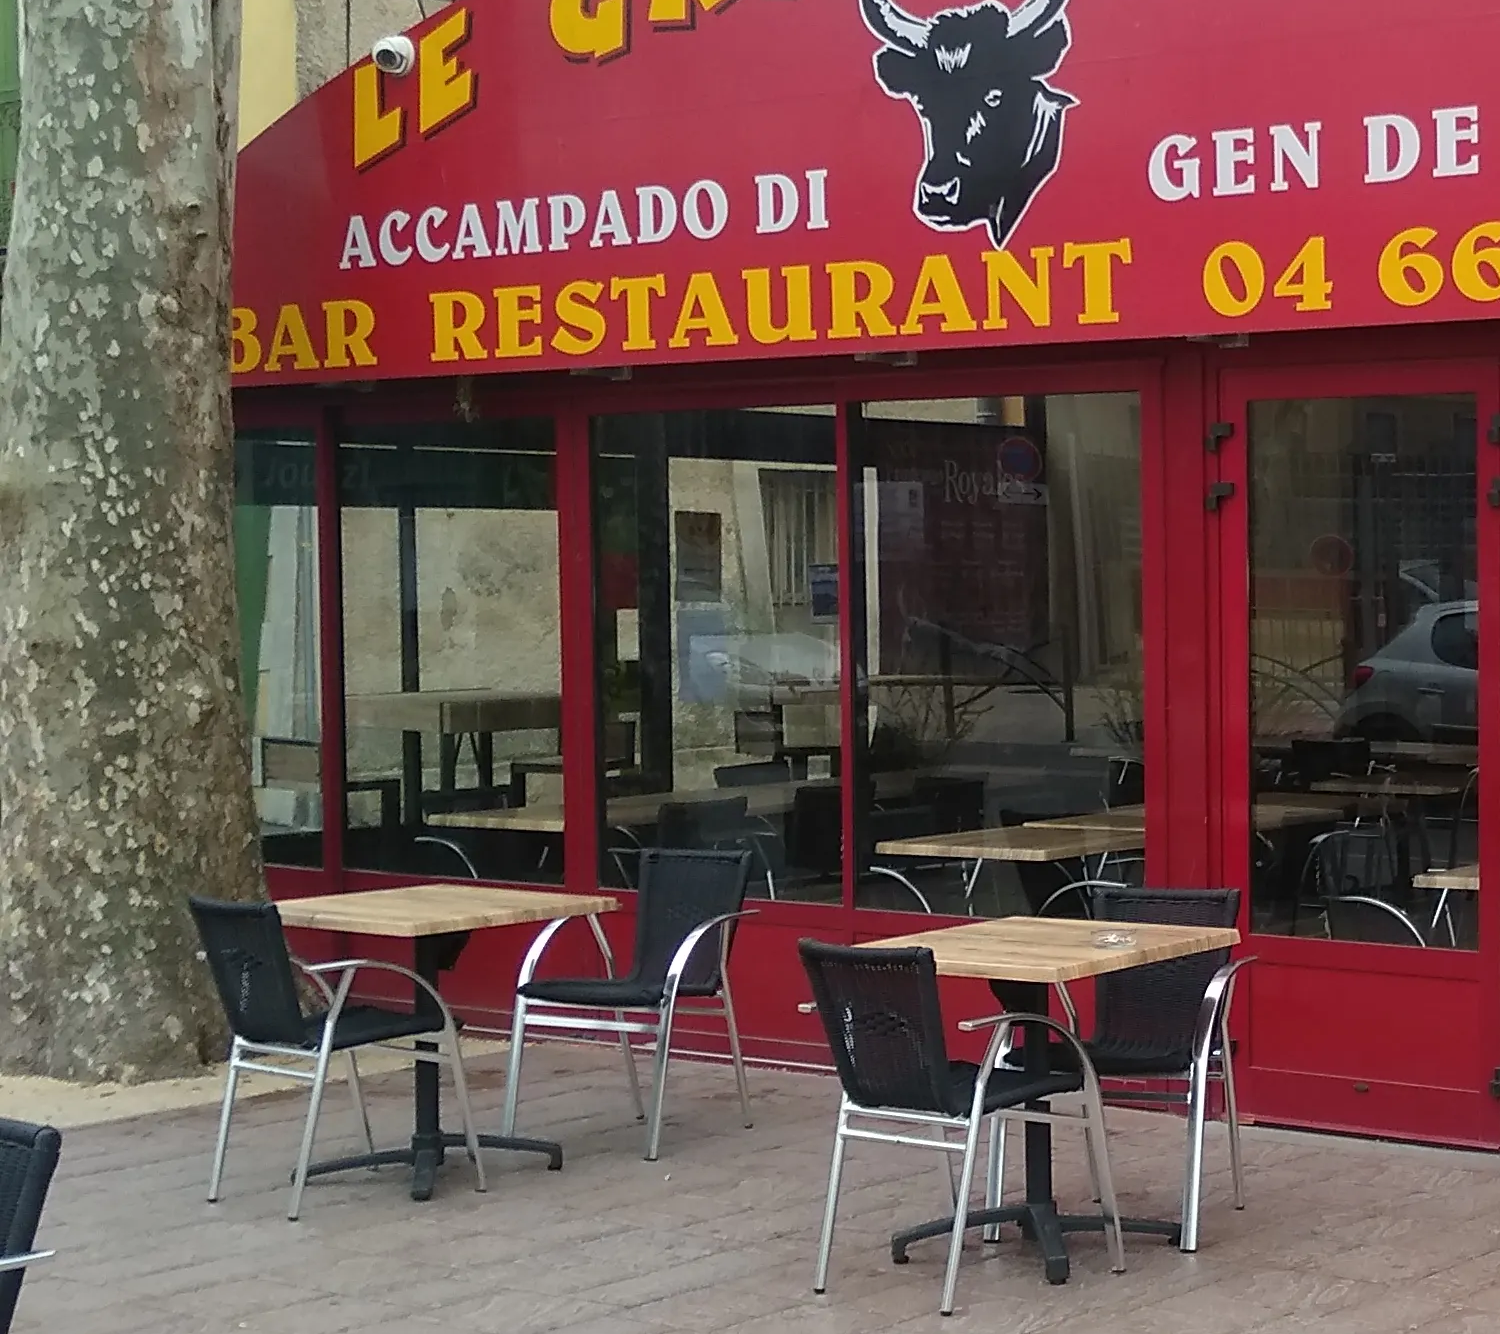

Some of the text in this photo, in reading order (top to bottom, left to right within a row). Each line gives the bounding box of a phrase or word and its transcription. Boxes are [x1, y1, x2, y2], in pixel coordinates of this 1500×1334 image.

[352, 5, 474, 171] LE
[338, 179, 729, 269] ACCAMPADO
[753, 168, 829, 234] DI
[1147, 120, 1322, 201] GEN
[1362, 104, 1480, 184] DE
[231, 299, 377, 373] BAR
[429, 237, 1132, 363] RESTAURANT
[1202, 236, 1333, 317] 04
